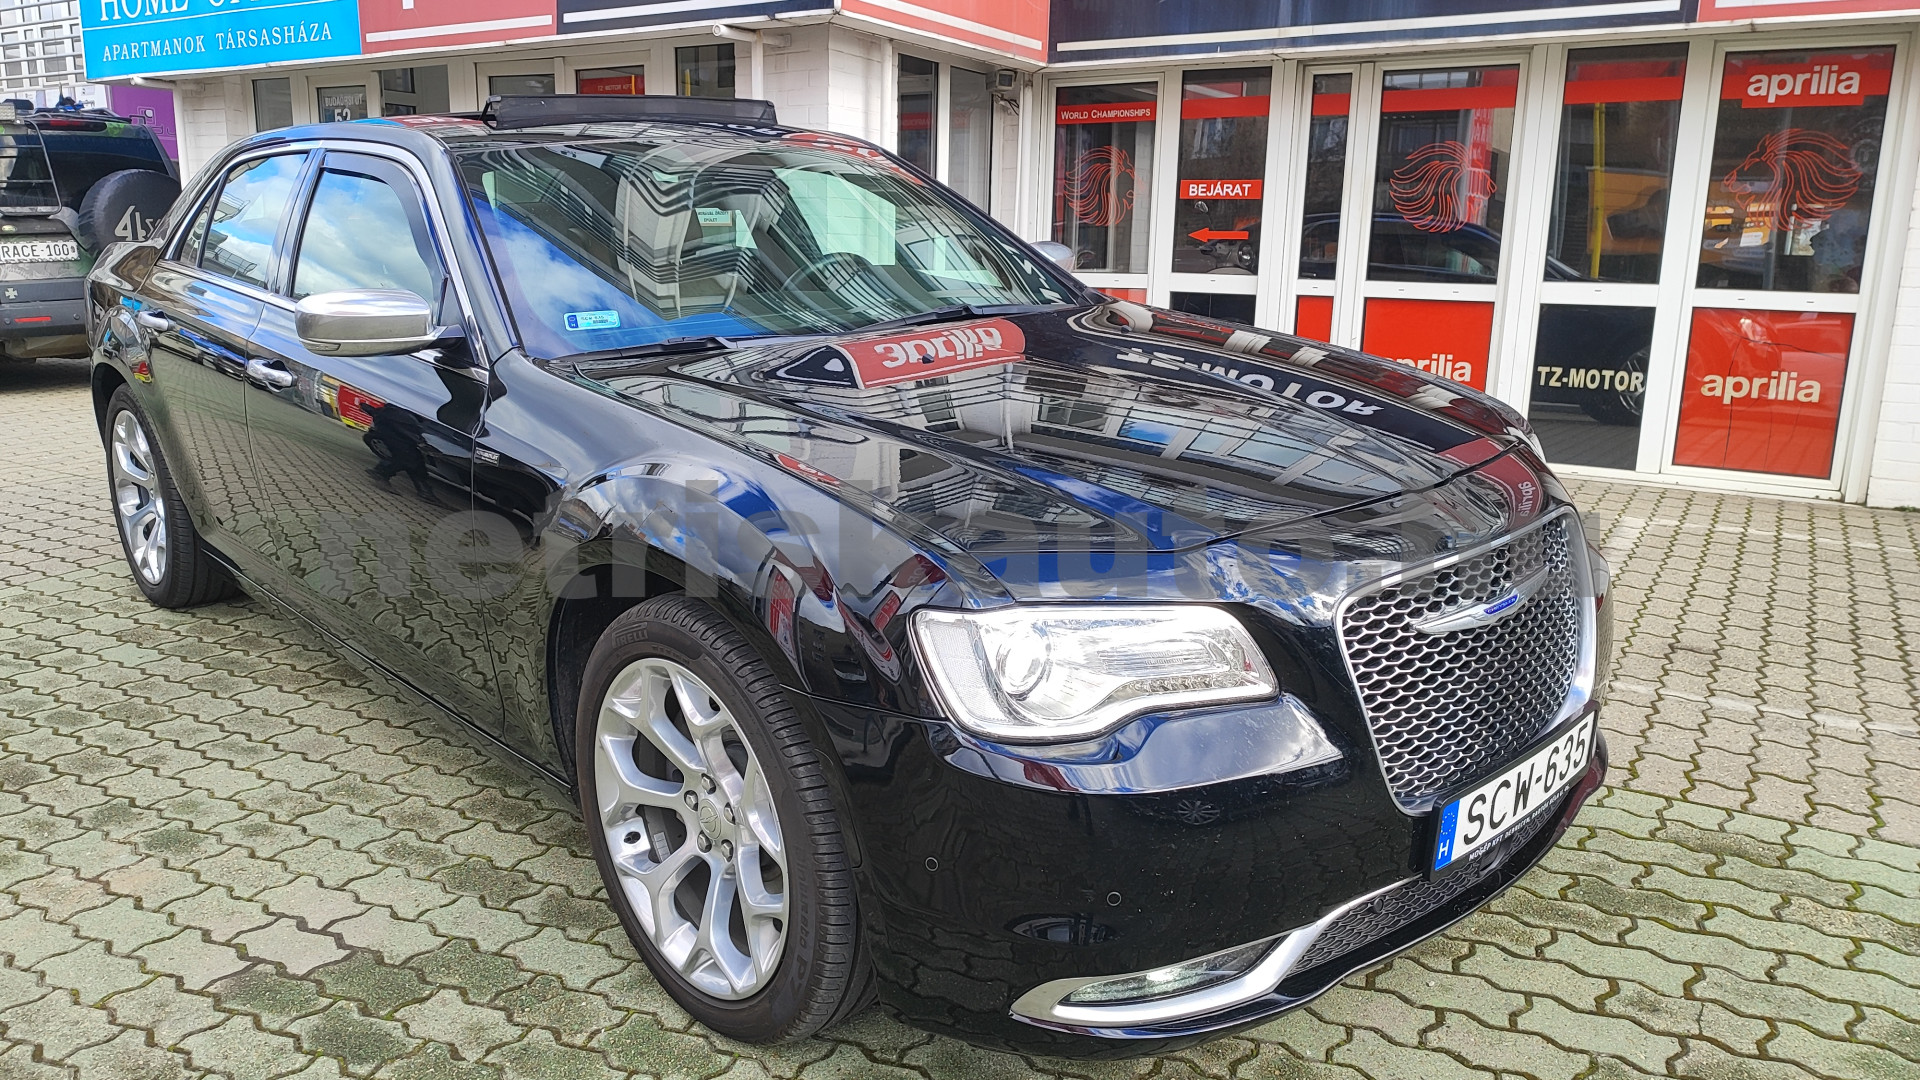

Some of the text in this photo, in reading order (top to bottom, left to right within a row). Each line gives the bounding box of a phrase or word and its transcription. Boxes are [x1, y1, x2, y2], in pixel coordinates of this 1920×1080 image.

[102, 21, 332, 62] APARTMANOK TÁRSASHÁZA
[1747, 65, 1861, 104] aprilia
[334, 108, 351, 122] 52
[1061, 108, 1151, 120] WORLD CHAMPIONSHIPS
[1188, 181, 1252, 197] BEJÁRAT
[1, 243, 70, 258] RACE-100
[1387, 353, 1472, 382] rilia
[1537, 366, 1645, 393] TZ-MOTOR
[1700, 370, 1822, 405] aprilia
[1437, 722, 1589, 860] H SCW-635
